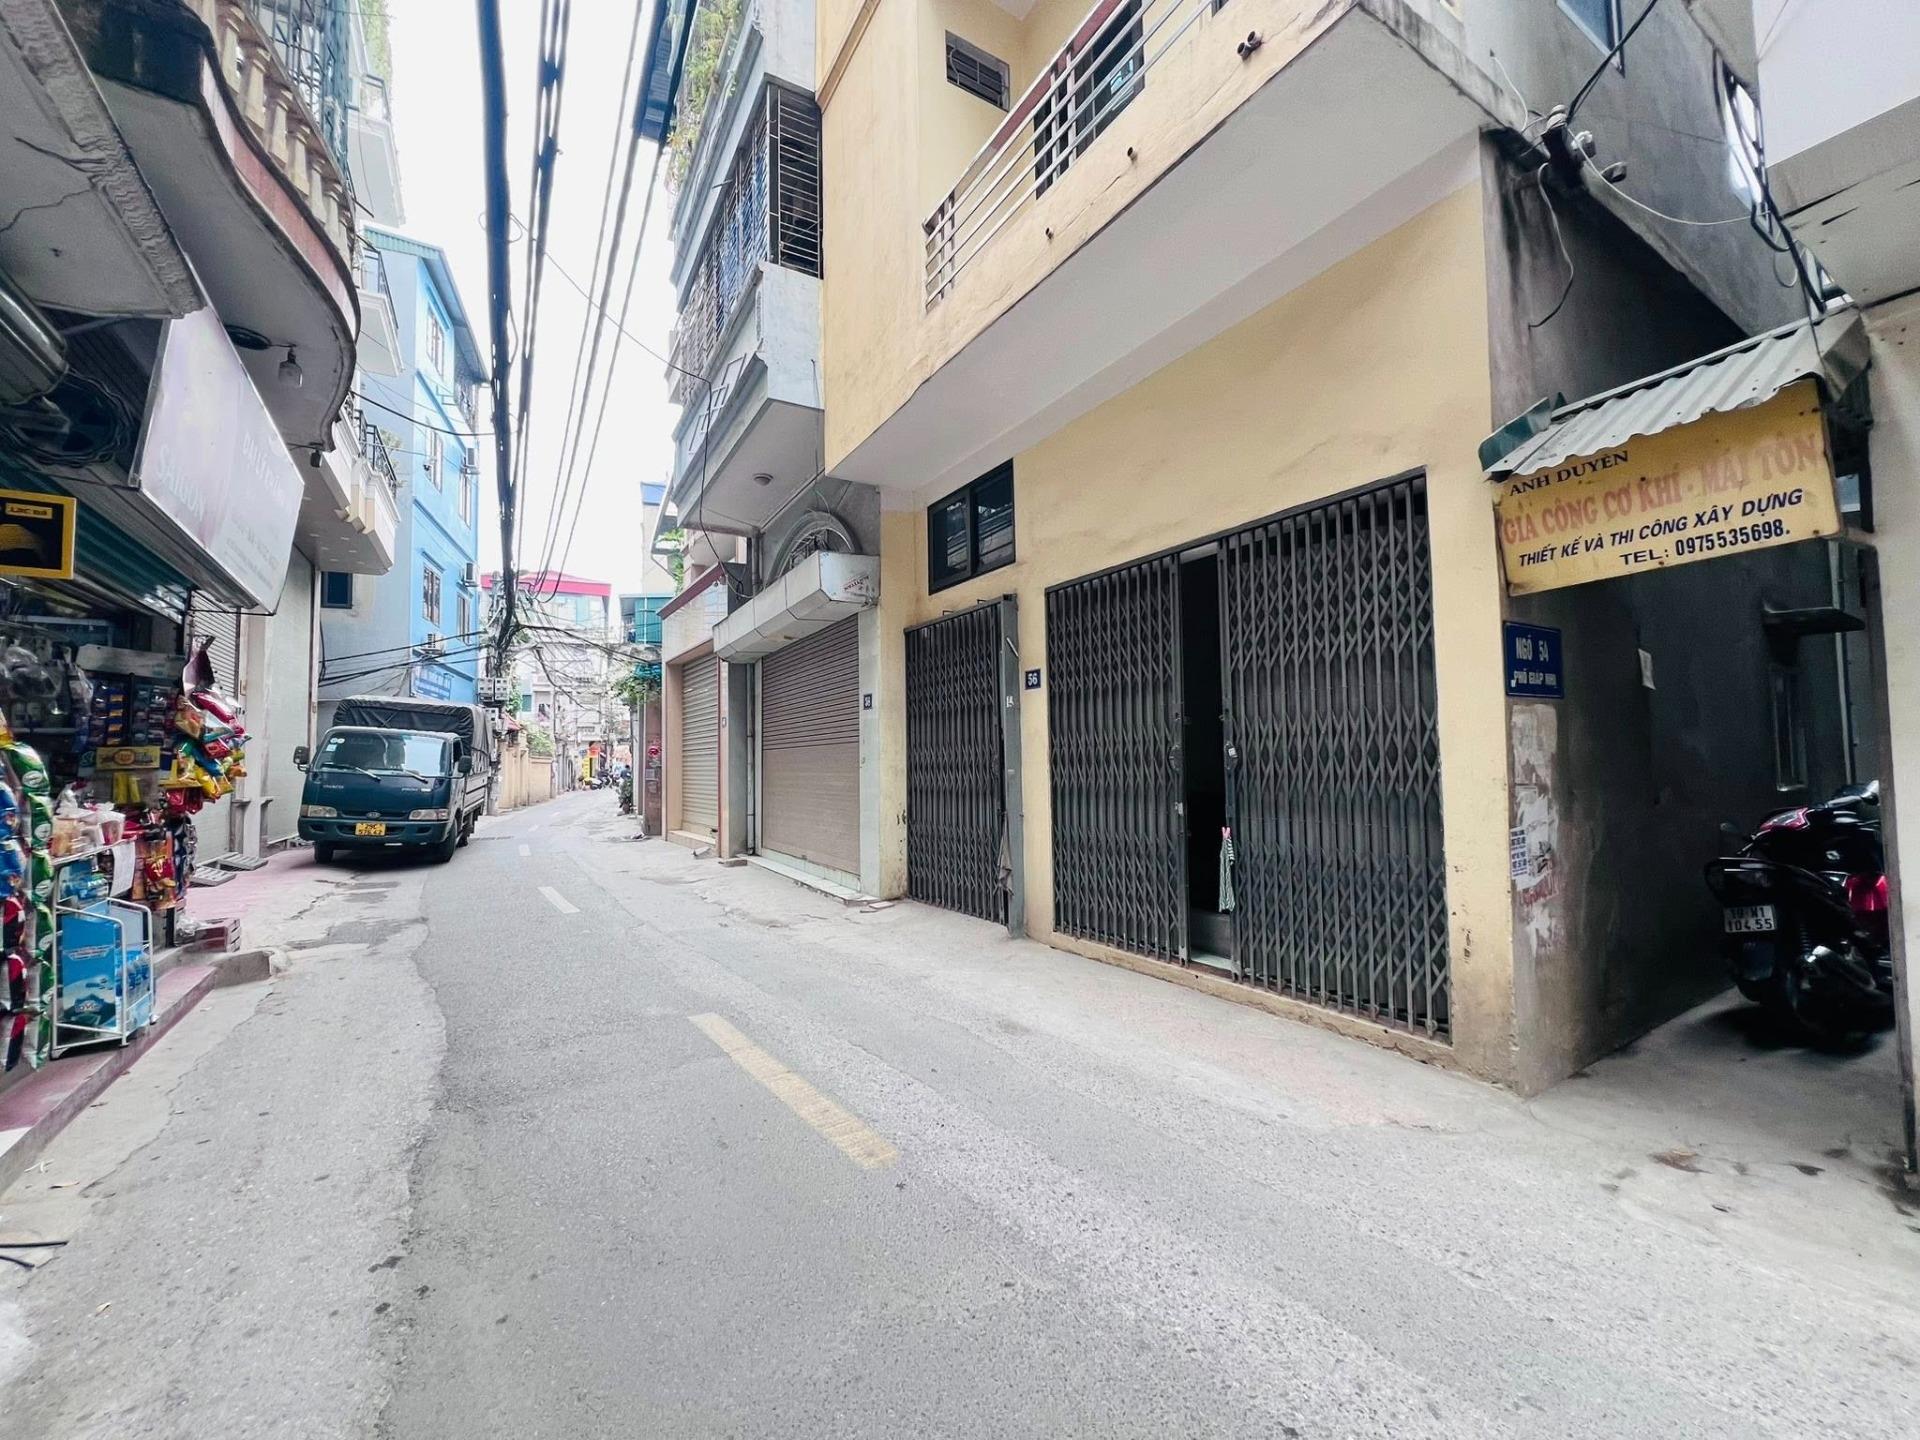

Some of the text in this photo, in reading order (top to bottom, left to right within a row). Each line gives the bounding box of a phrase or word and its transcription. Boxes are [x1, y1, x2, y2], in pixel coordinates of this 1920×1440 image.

[1510, 451, 1629, 496] ANH DUYÊN
[1503, 513, 1538, 545] GIA
[1541, 496, 1598, 536] CÔNG
[1519, 488, 1803, 567] THIẾT KẾ VÀ THI CÔNG XÂY DỰNG
[1027, 672, 1038, 686] 56
